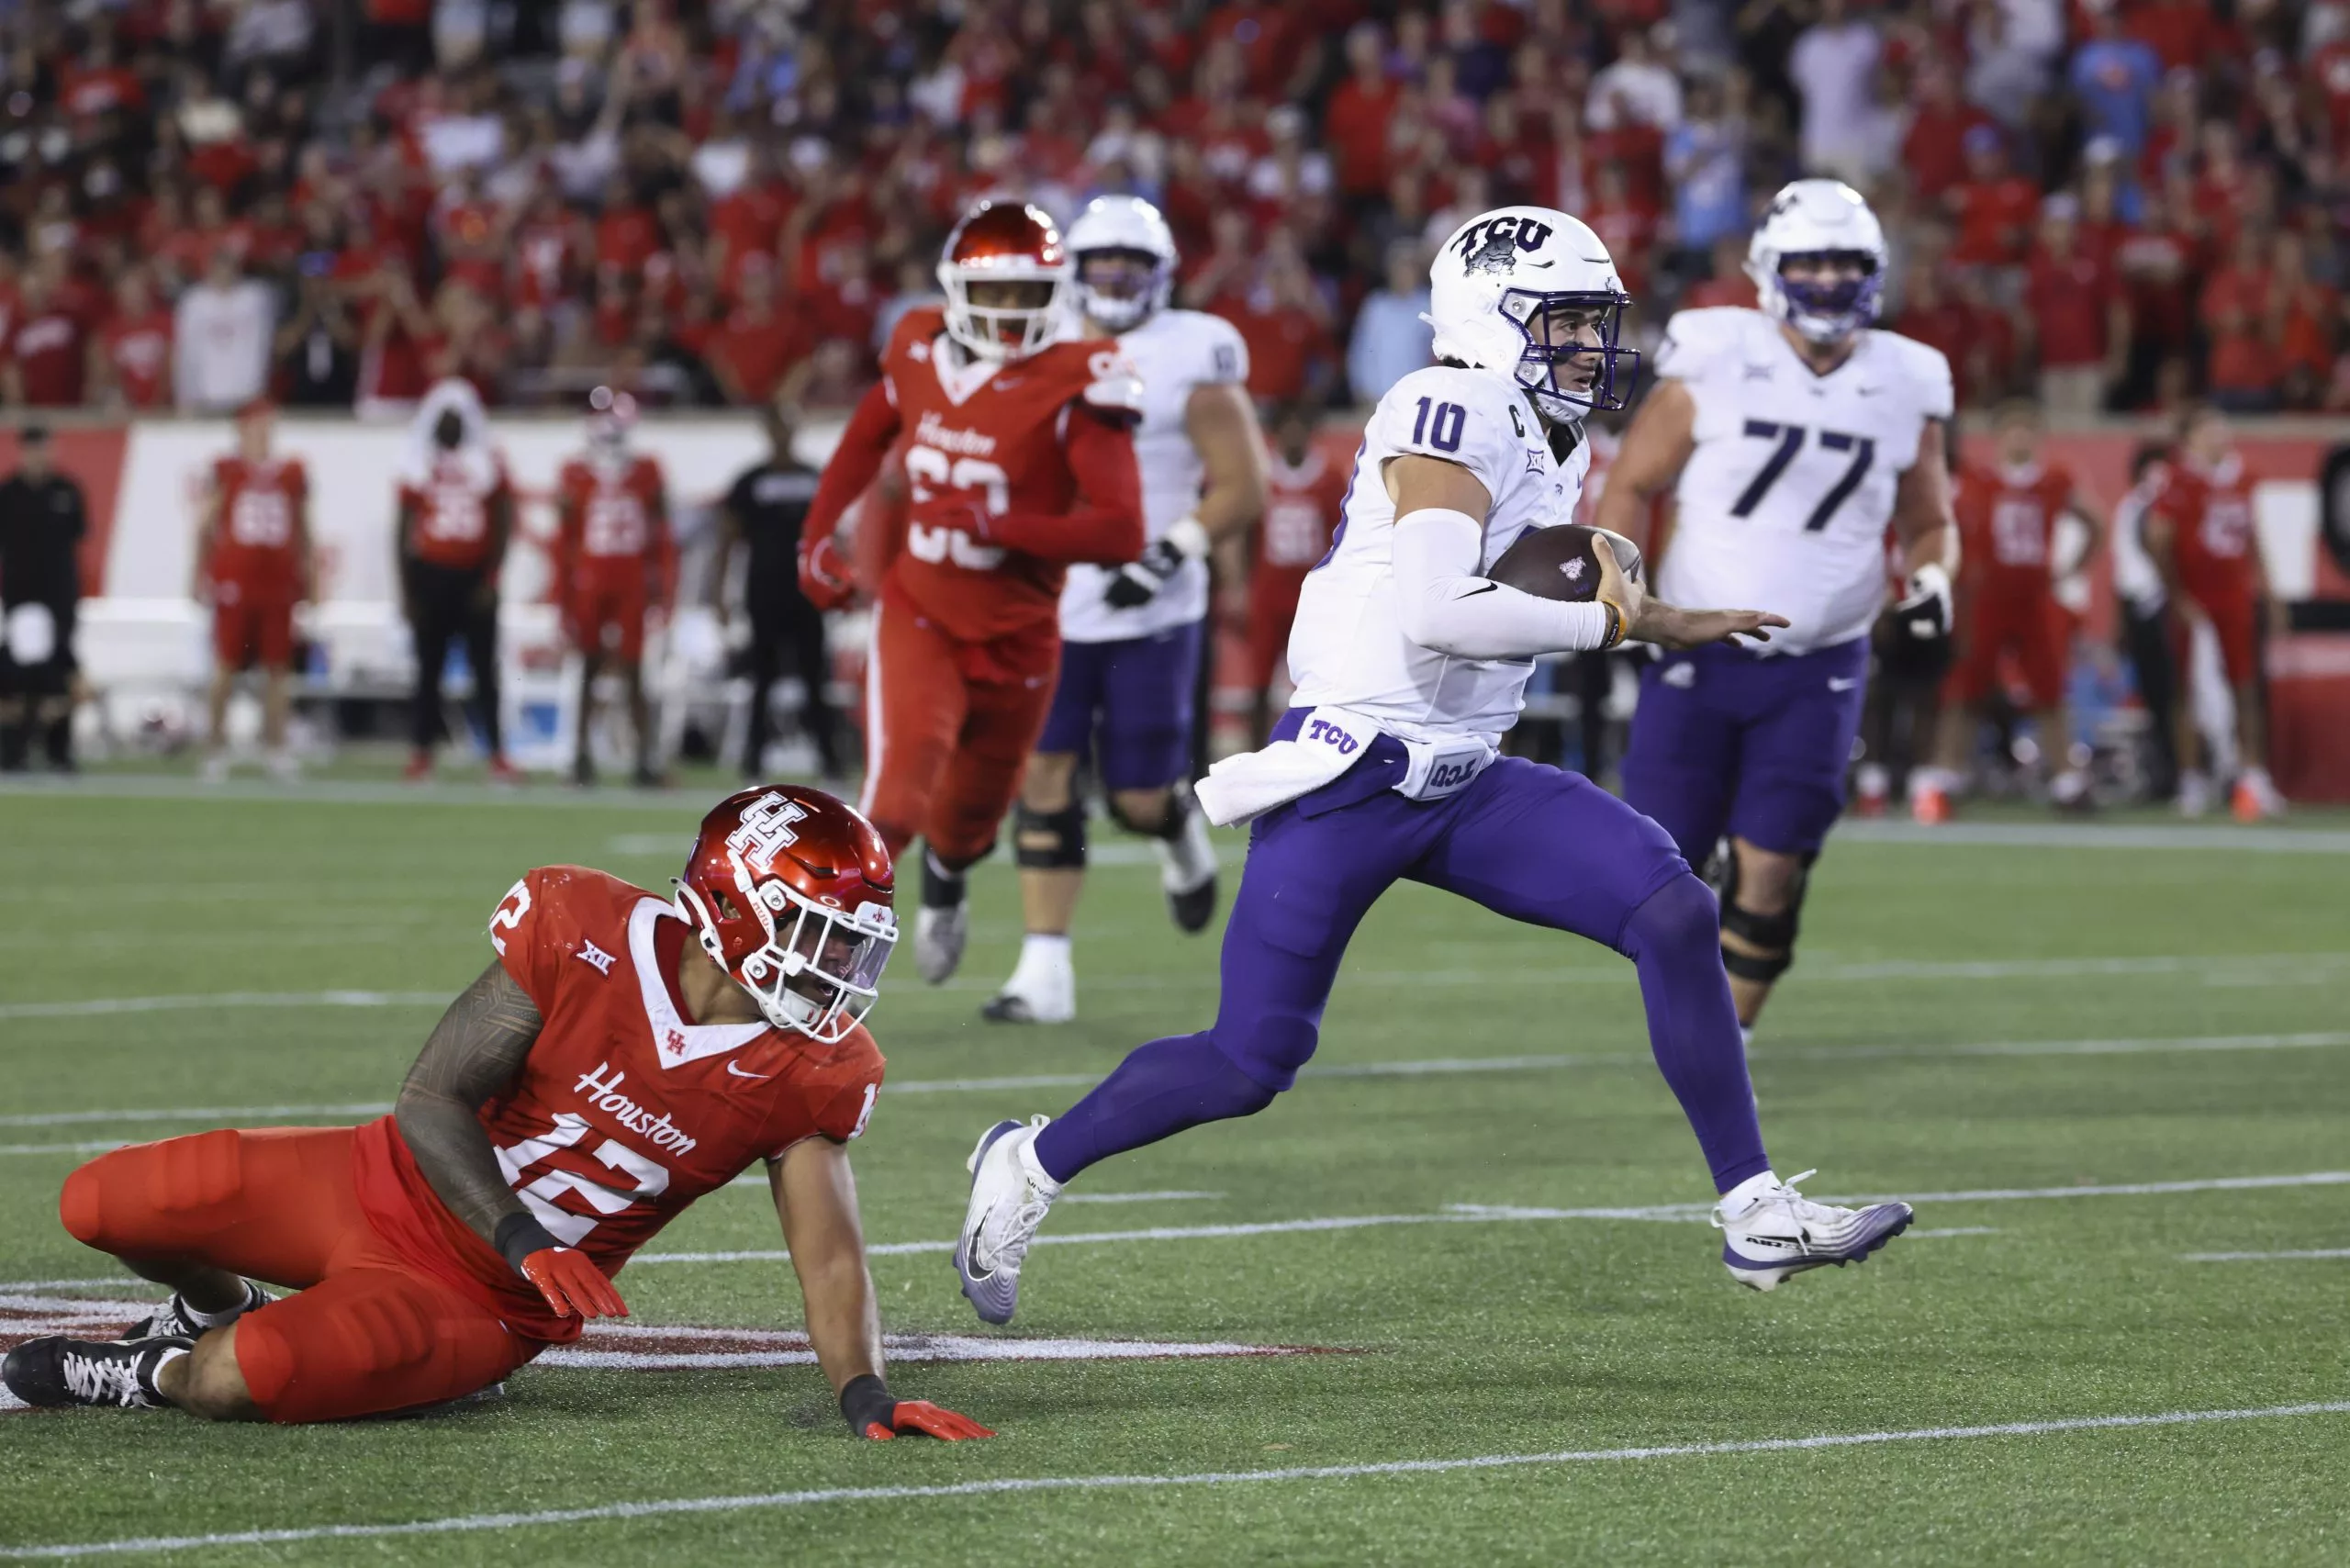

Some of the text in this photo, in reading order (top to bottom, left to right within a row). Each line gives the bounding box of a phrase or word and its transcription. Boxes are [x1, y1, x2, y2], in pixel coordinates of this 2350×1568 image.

[1450, 216, 1553, 258] TCU
[1412, 396, 1466, 454] 10
[1508, 404, 1525, 438] C
[1729, 419, 1874, 532] 77
[1309, 719, 1359, 755] TCU
[1430, 758, 1477, 788] TCU
[574, 1060, 697, 1157] Houston
[493, 1113, 669, 1247] 12
